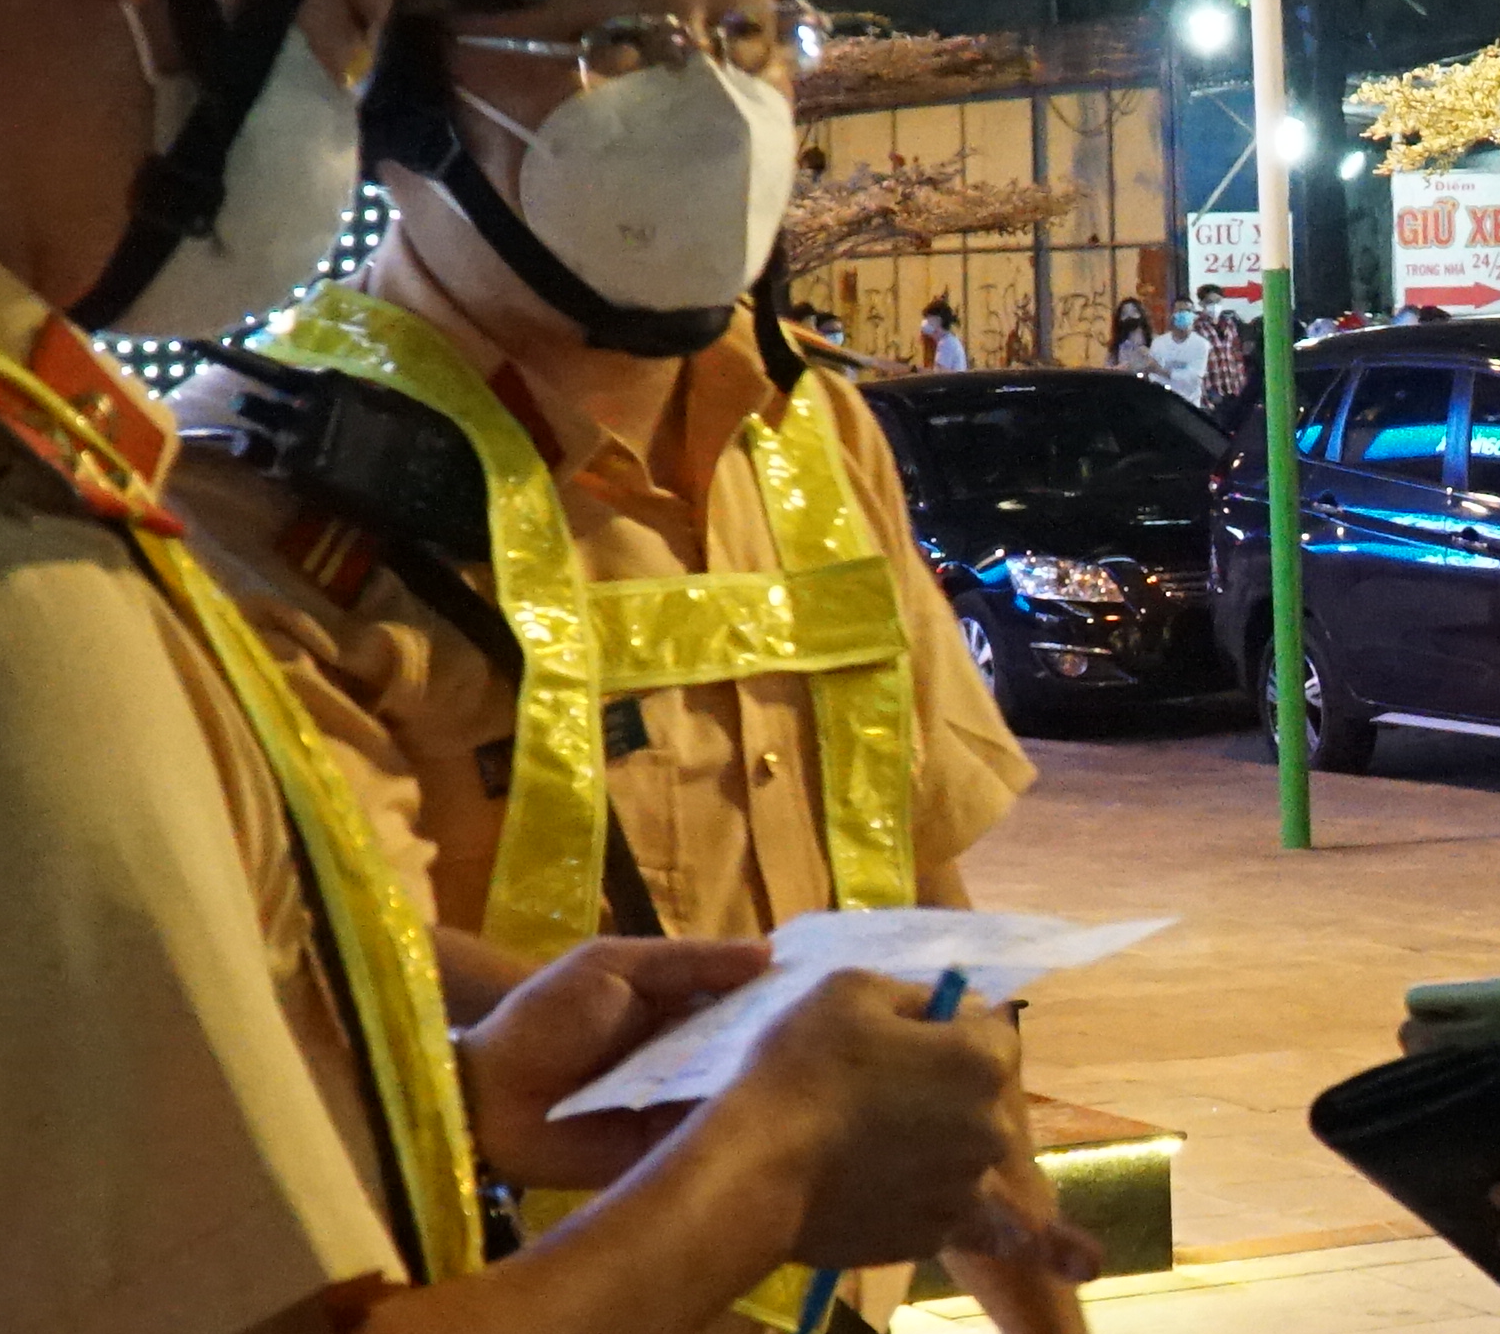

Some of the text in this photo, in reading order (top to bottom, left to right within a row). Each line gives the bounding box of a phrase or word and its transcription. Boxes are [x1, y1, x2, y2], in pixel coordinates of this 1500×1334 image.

[1195, 218, 1244, 245] GIỮ
[1396, 196, 1461, 250] GIỮ
[1204, 252, 1262, 273] 24/2
